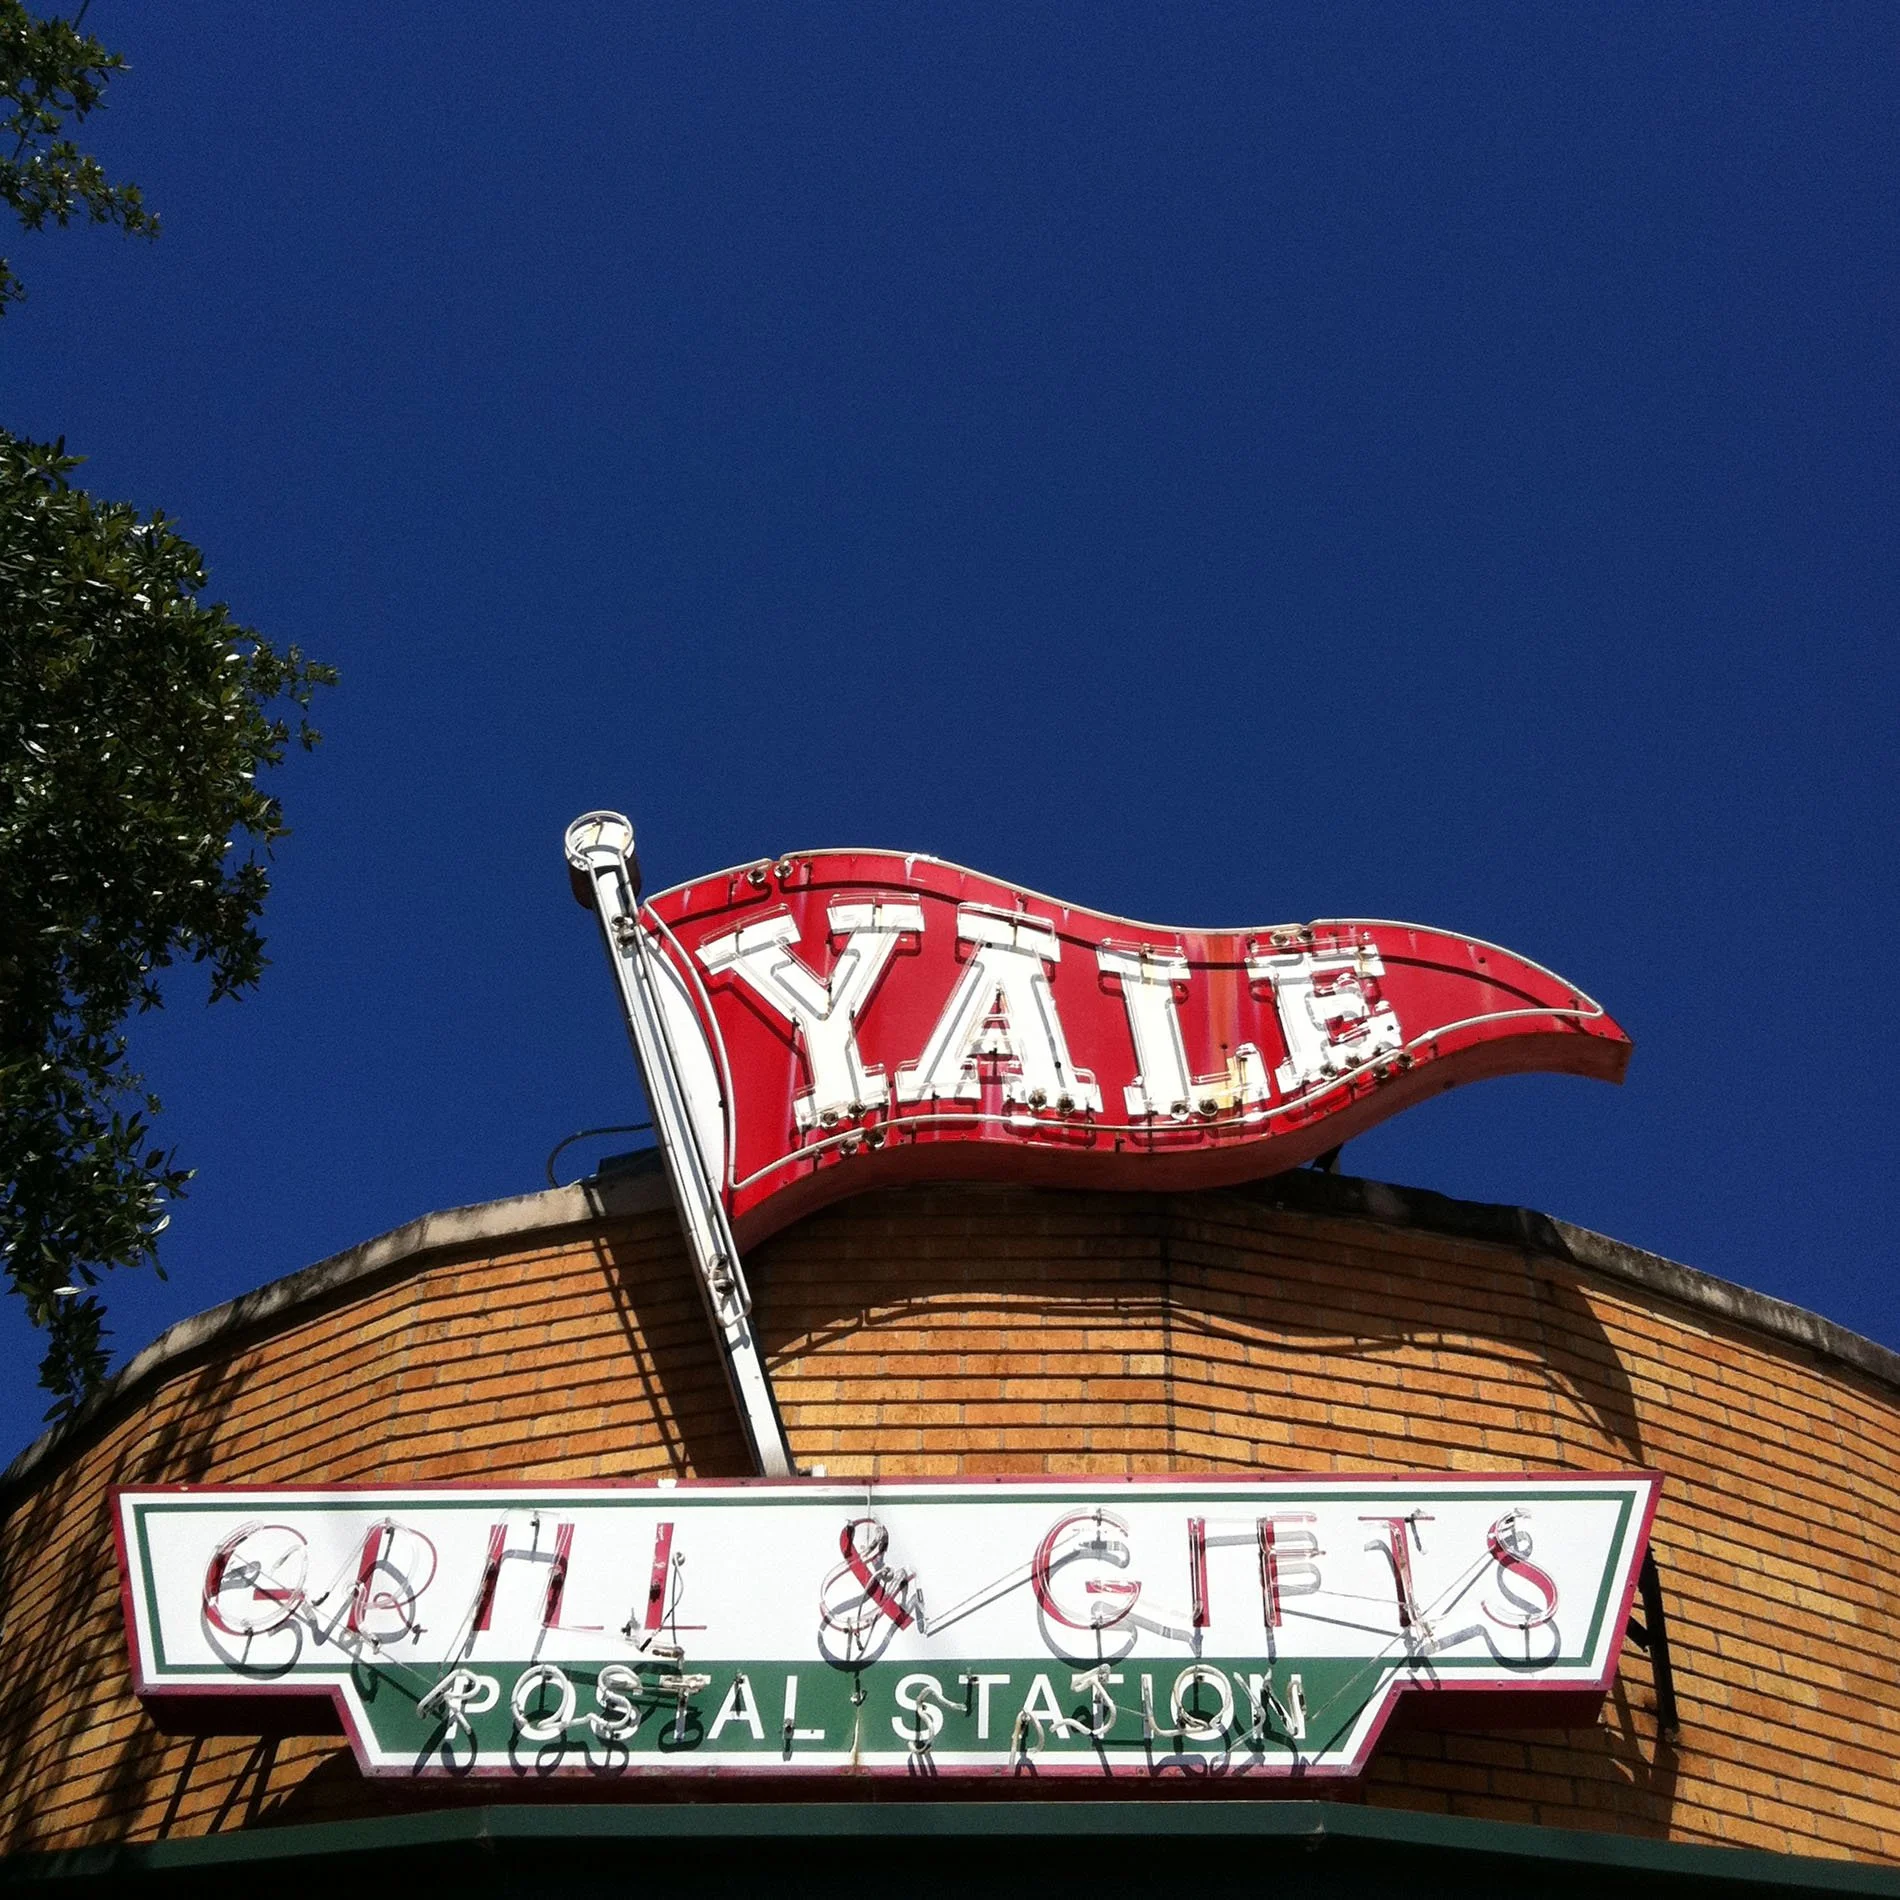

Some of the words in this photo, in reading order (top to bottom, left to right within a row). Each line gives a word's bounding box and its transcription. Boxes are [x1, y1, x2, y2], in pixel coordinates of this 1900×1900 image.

[695, 902, 1403, 1127] YALE
[202, 1520, 707, 1637] GRILL
[819, 1517, 916, 1631] &
[1031, 1513, 1559, 1630] GIFTS
[440, 1671, 826, 1742] POSTAL
[891, 1672, 1308, 1741] STATION
